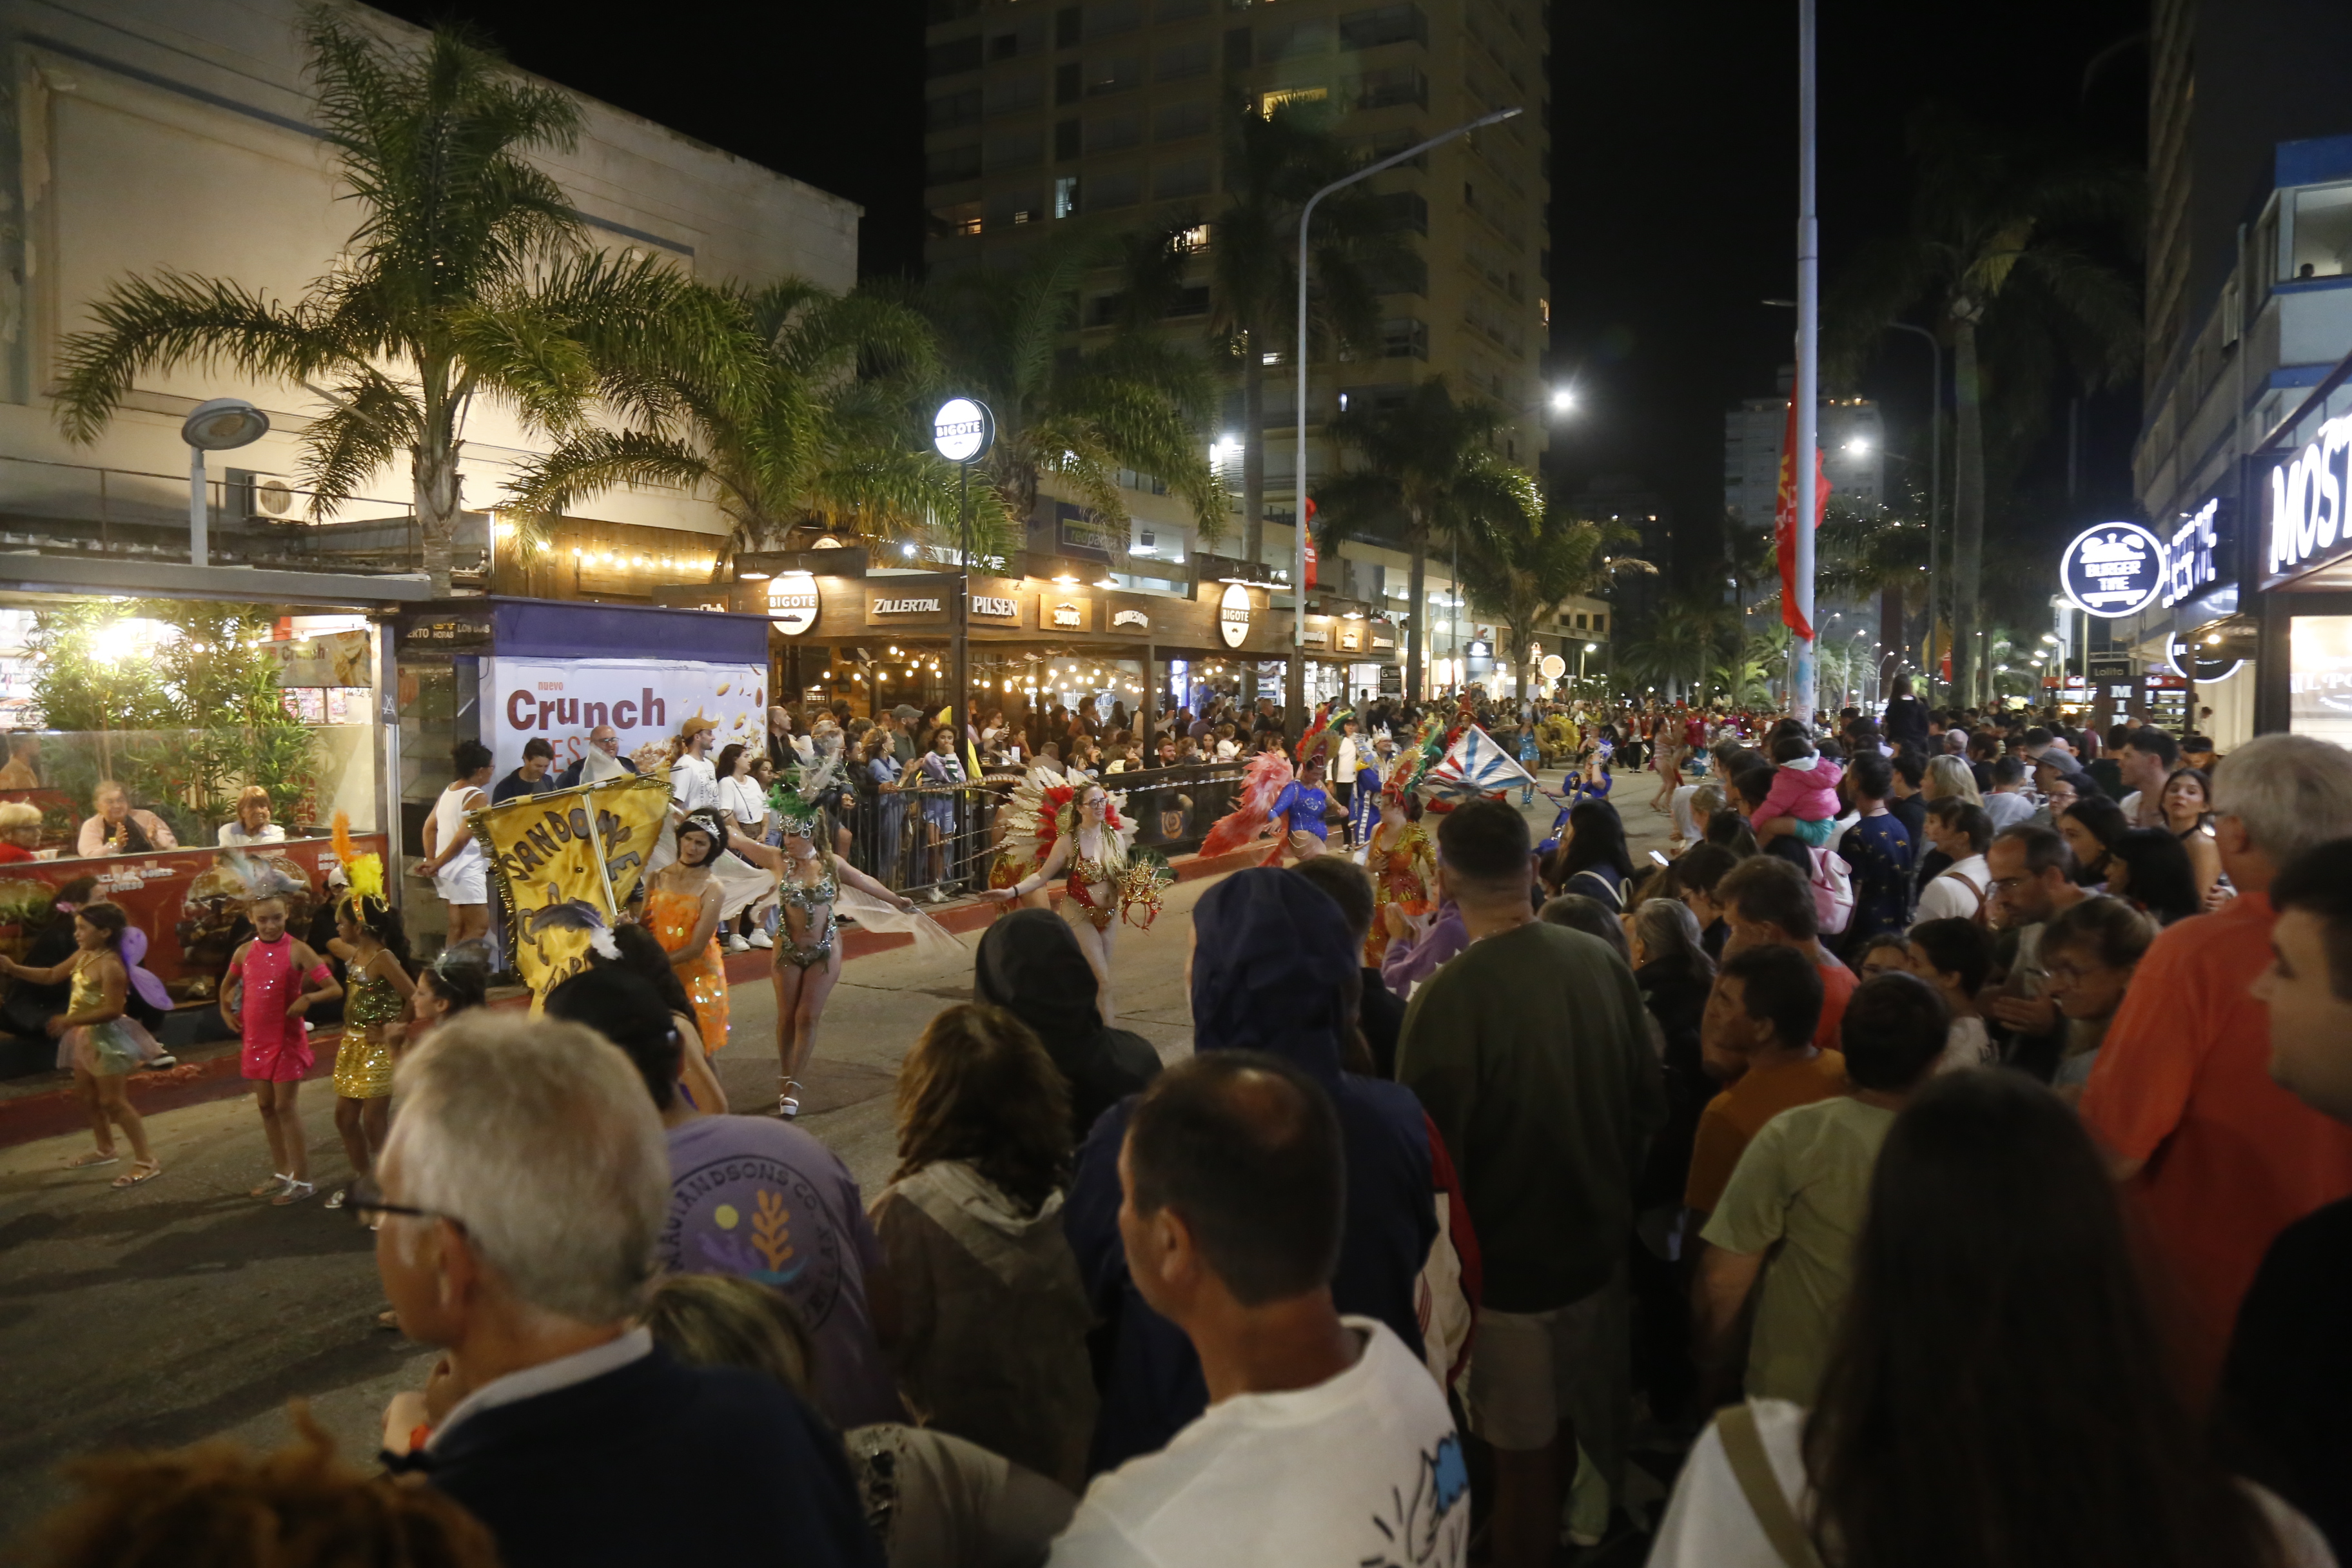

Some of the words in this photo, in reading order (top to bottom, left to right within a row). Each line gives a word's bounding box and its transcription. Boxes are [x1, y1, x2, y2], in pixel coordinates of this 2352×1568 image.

[936, 421, 980, 437] BIGOTE
[2085, 560, 2141, 578] BURGER
[770, 596, 816, 607] BIGOTE
[872, 598, 941, 614] ZILLERTAL
[972, 596, 1017, 616] PILSEN
[1222, 609, 1249, 622] BIGOTE
[2095, 667, 2124, 676] Lolita
[538, 681, 564, 691] nuevo
[507, 687, 665, 730] Crunch
